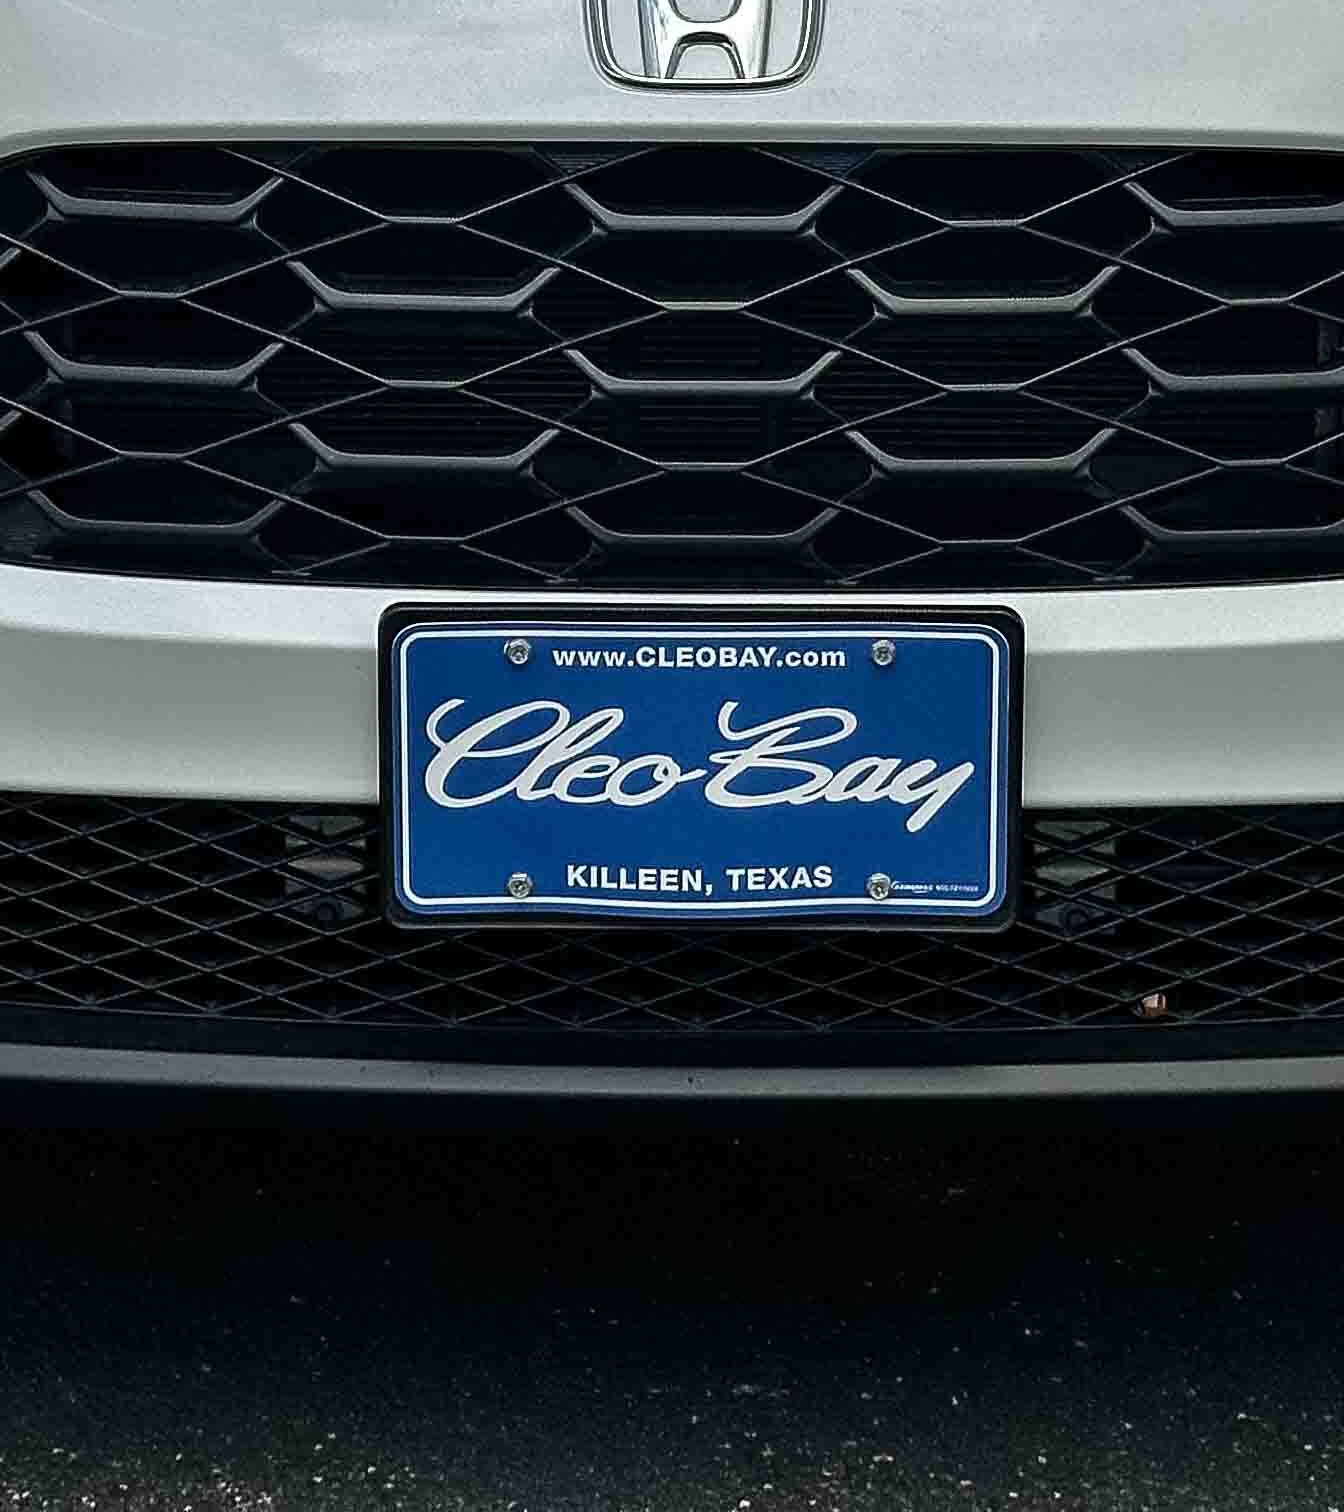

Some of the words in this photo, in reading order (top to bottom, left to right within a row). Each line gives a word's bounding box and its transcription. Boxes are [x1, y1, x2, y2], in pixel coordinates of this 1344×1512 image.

[552, 645, 847, 669] www.CLEOBAY.com
[423, 698, 706, 809] Cleo
[704, 700, 975, 833] Bay
[566, 864, 714, 897] KILLEEN,
[726, 865, 833, 890] TEXAS
